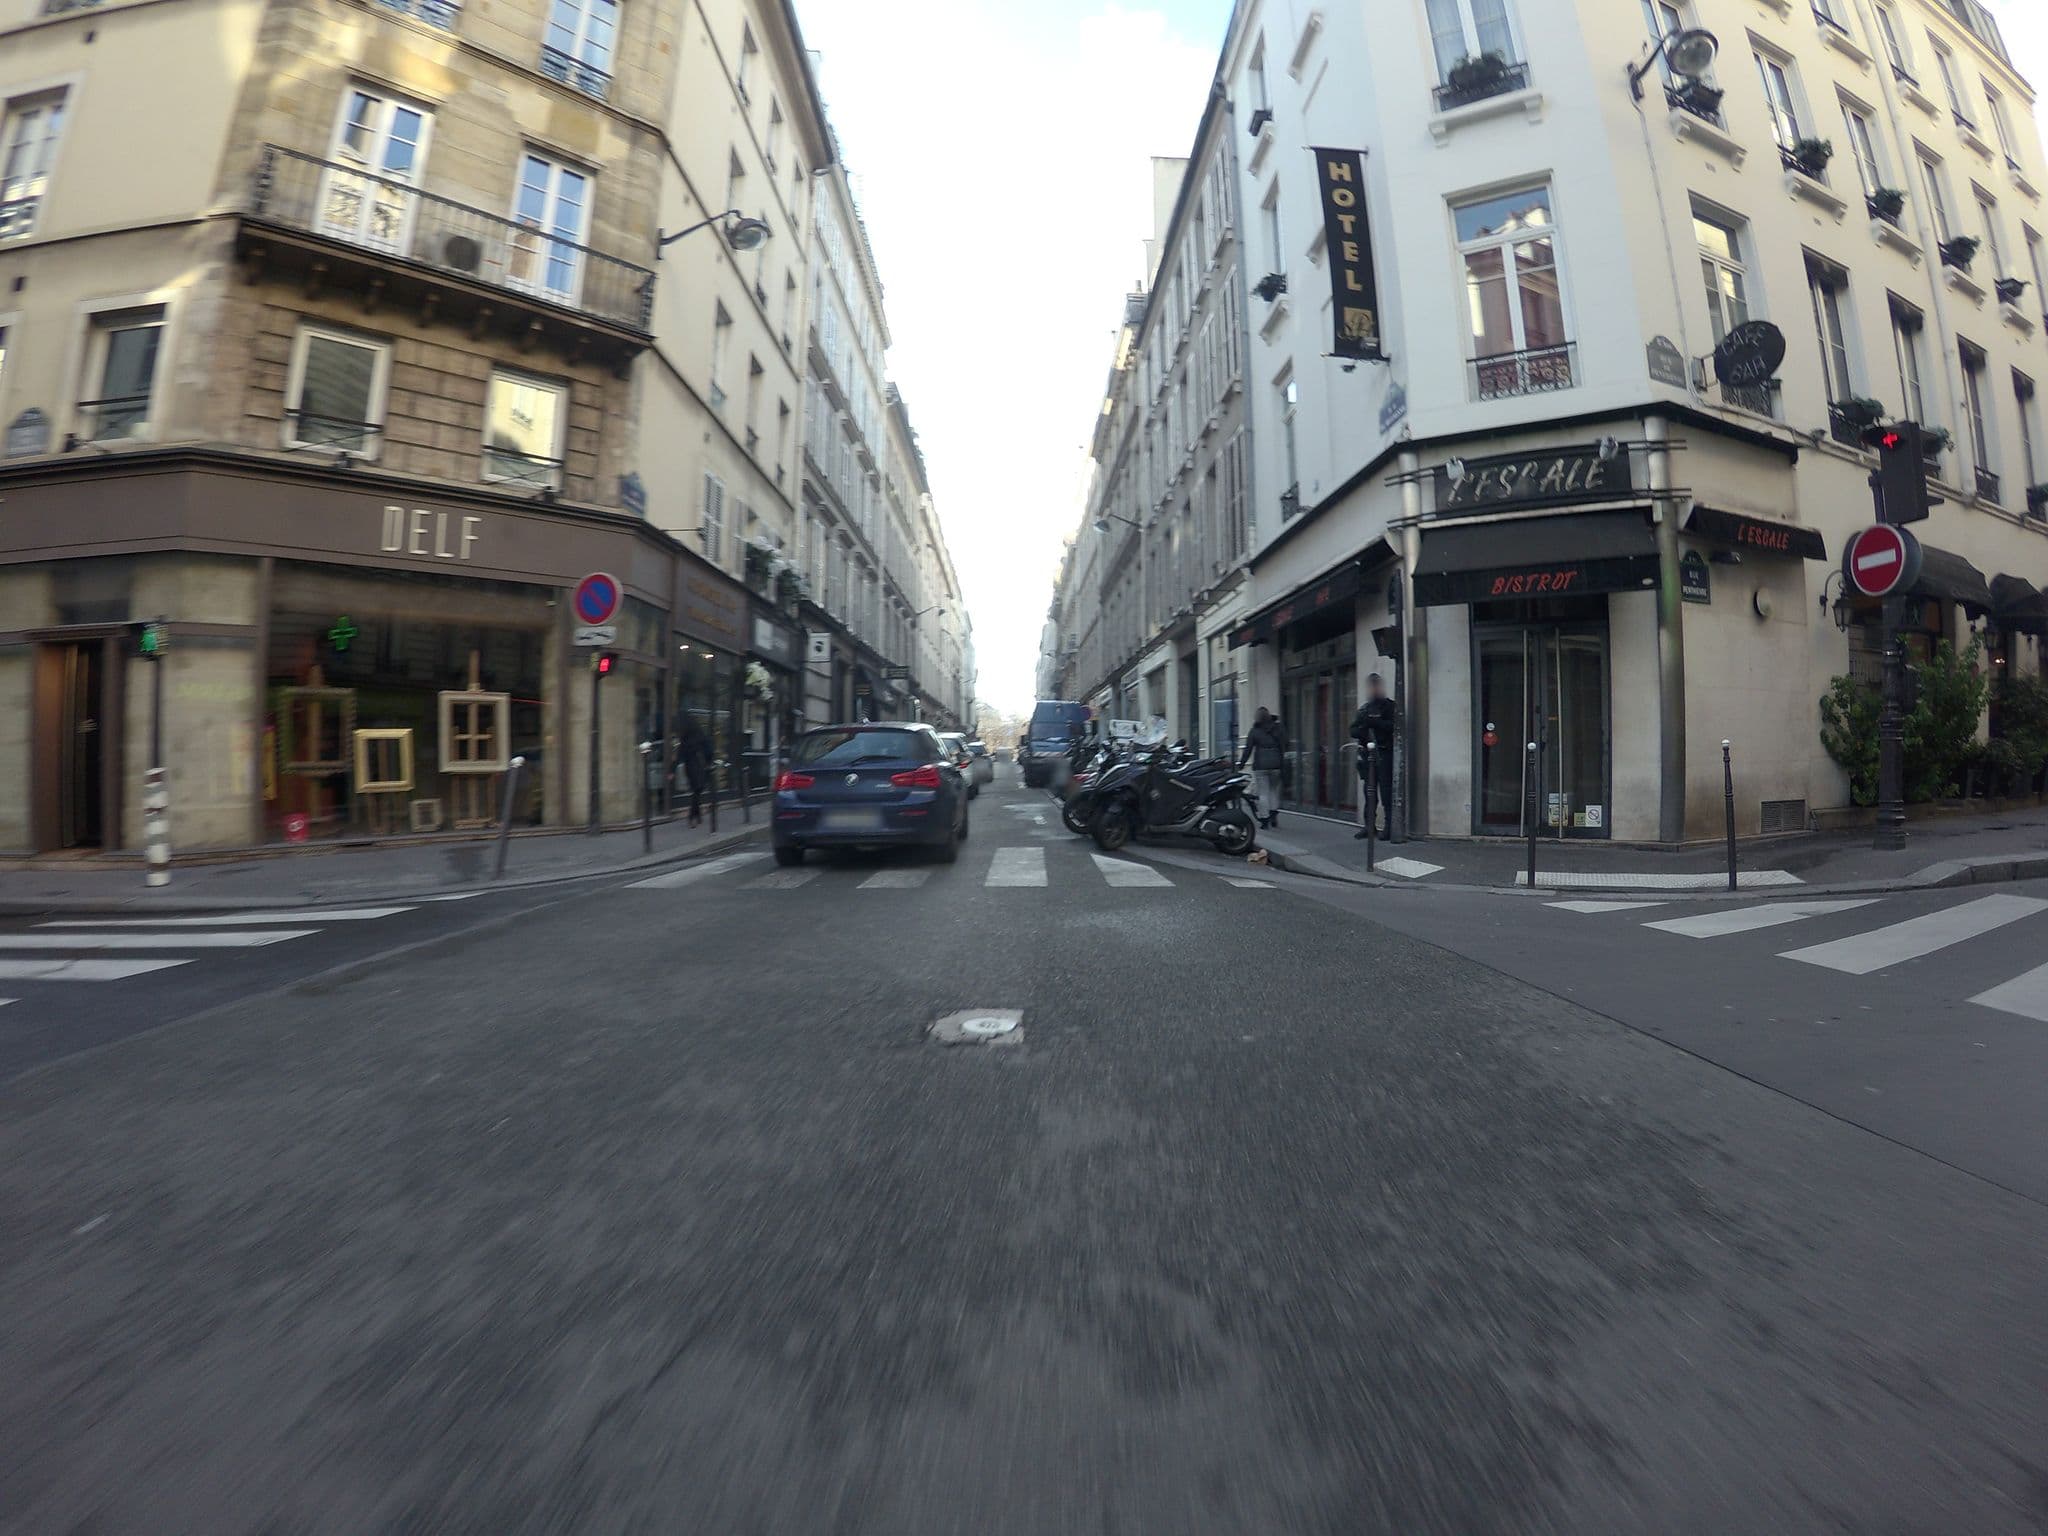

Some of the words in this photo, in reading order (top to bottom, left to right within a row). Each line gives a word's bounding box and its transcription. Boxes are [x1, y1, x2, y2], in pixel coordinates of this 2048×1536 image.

[1328, 162, 1363, 291] HOTEL
[381, 506, 483, 560] DELF
[1491, 570, 1577, 595] BISTROT
